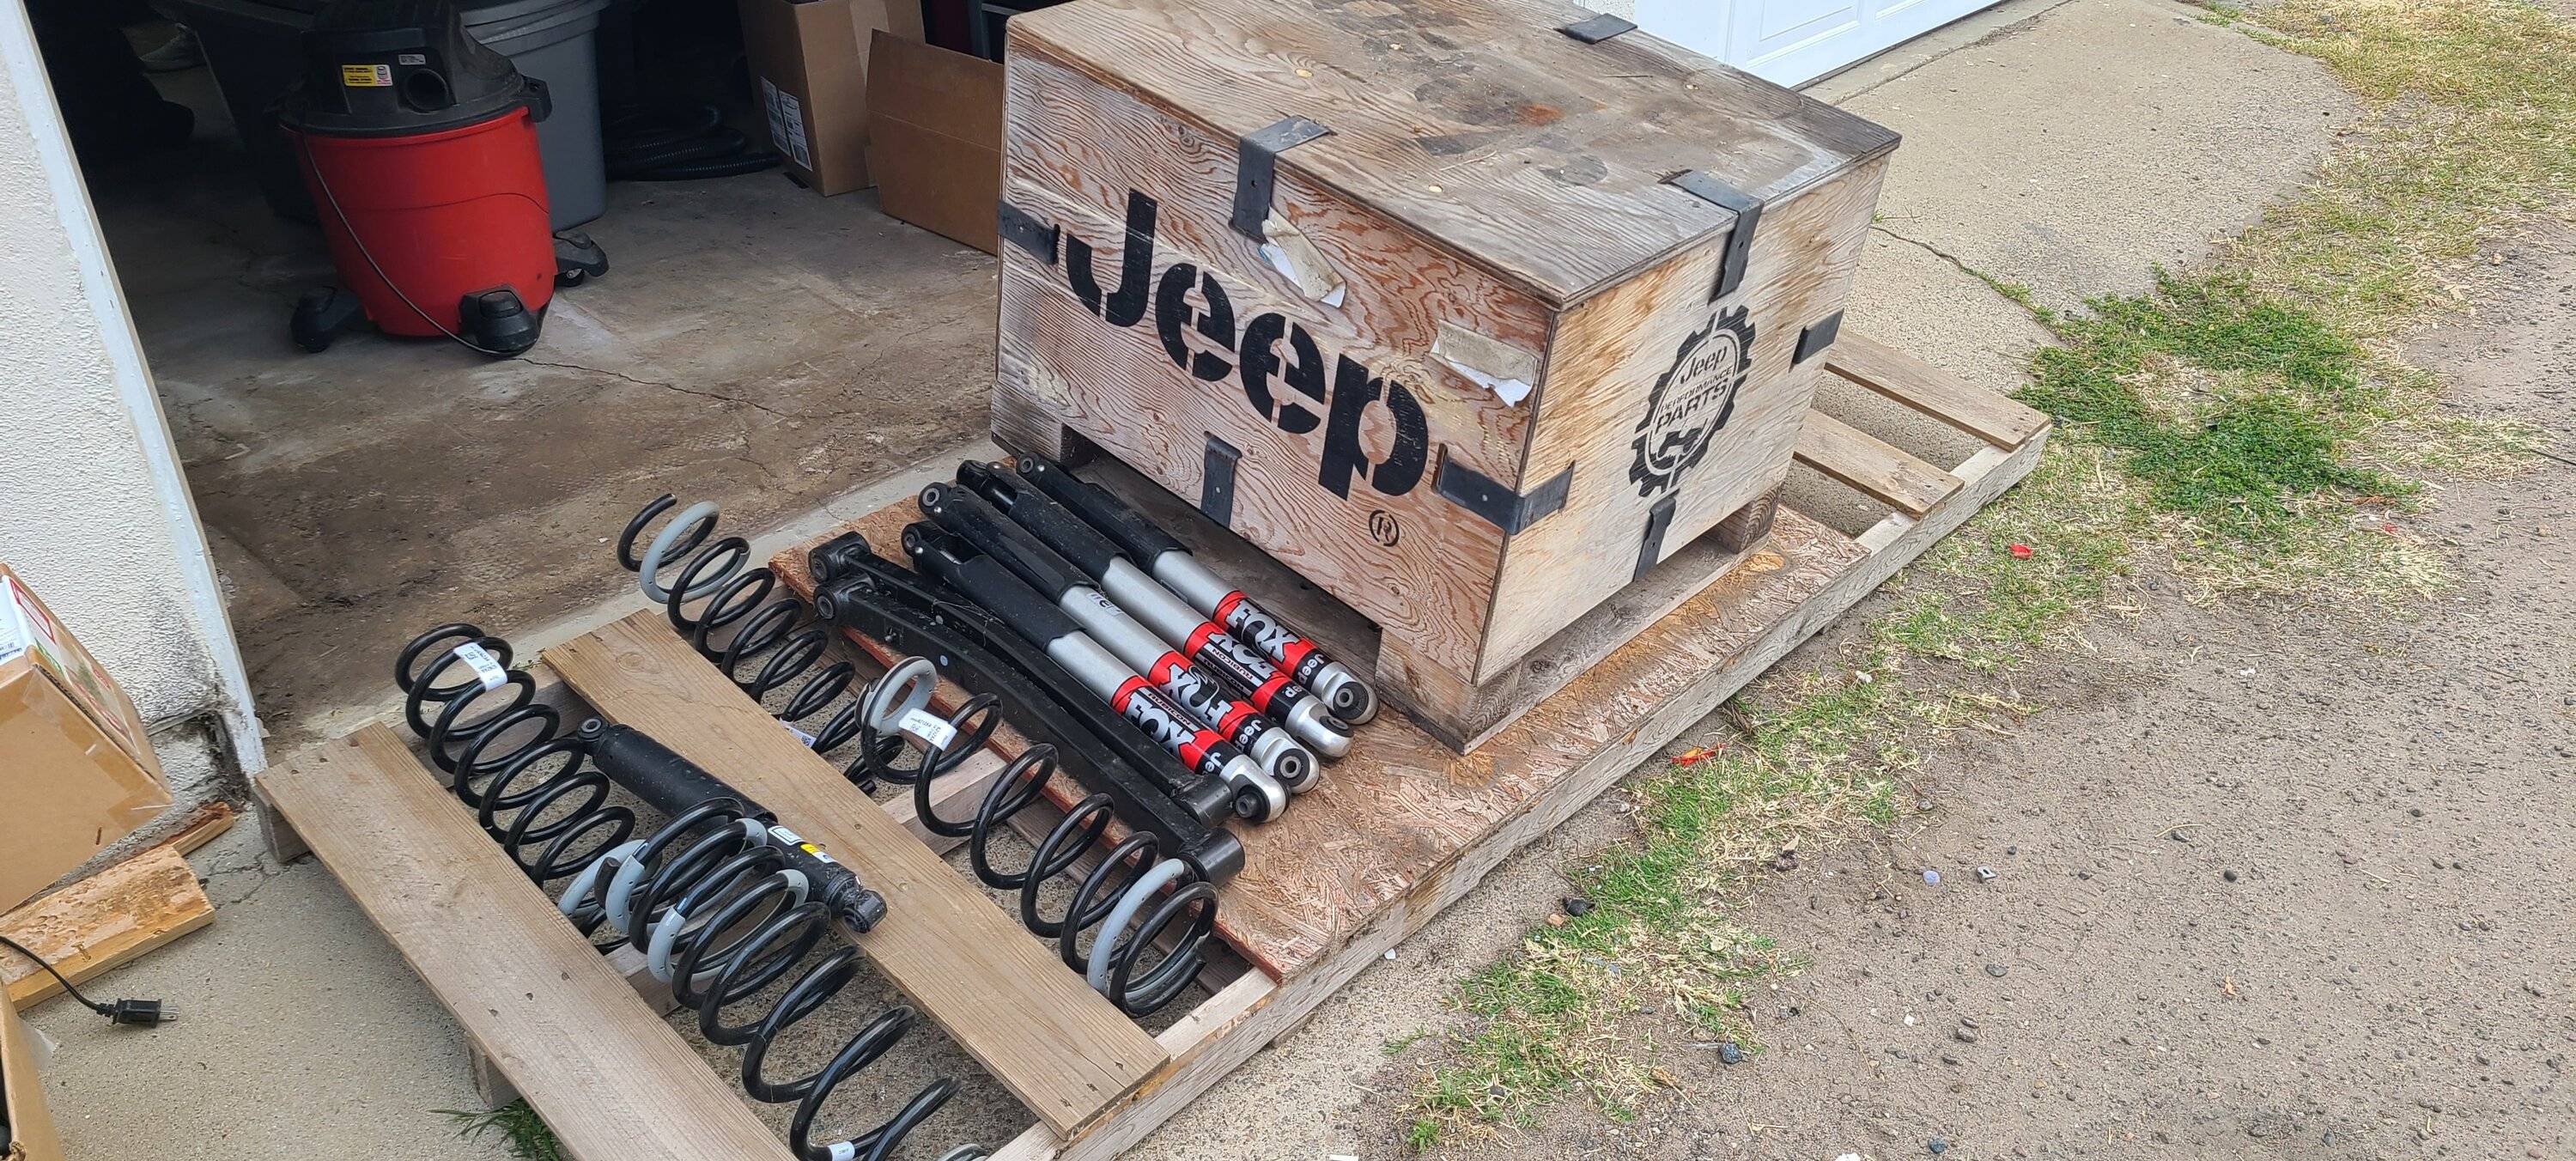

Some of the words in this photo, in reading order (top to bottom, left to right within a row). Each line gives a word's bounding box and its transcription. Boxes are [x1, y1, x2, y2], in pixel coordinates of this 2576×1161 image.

[1066, 187, 1429, 501] Jeep
[1680, 346, 1728, 384] Jeep
[1655, 378, 1728, 435] PARTS
[1661, 365, 1734, 412] PERFORMANCE
[1225, 599, 1301, 663] FOX
[1212, 648, 1254, 680] RUBICON
[1297, 653, 1324, 684] Jeep
[1148, 693, 1191, 726] RUBICON
[1159, 663, 1234, 732] FOX
[1124, 691, 1196, 763] FOX
